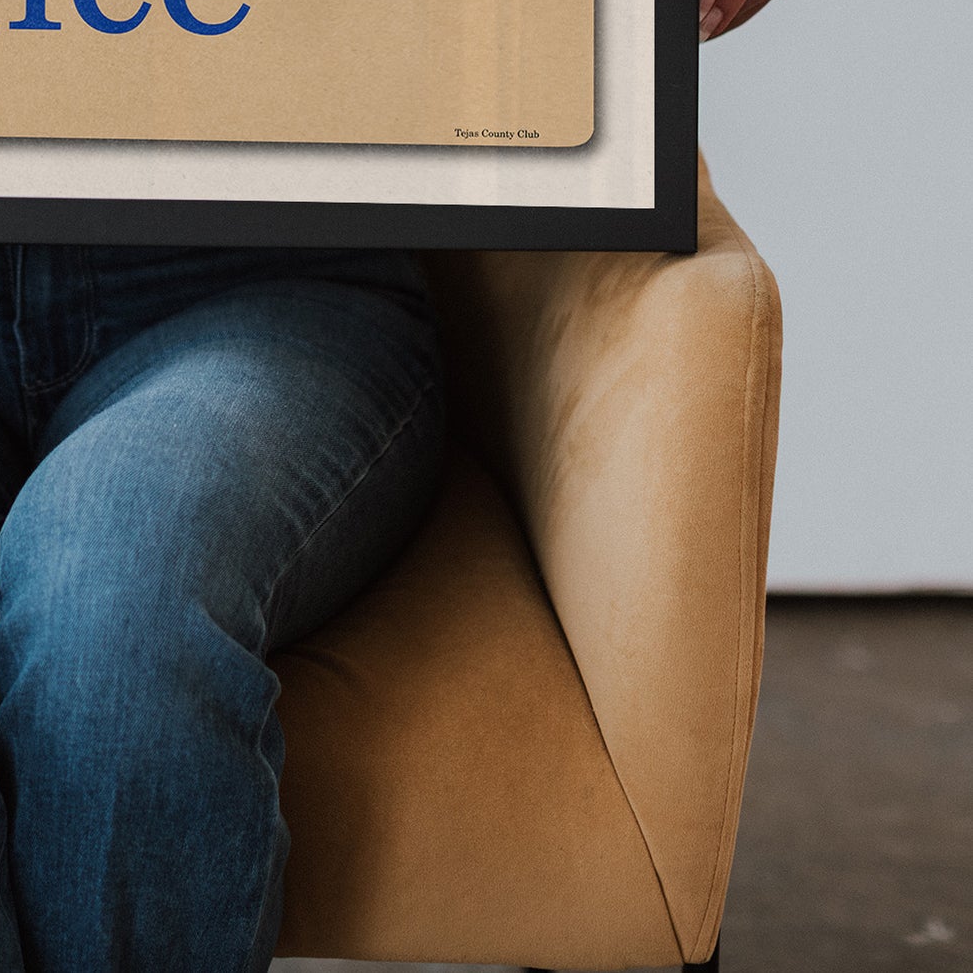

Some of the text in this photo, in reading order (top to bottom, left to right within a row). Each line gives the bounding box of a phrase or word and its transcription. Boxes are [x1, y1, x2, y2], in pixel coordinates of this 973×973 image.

[454, 128, 540, 140] Tejas County Club
